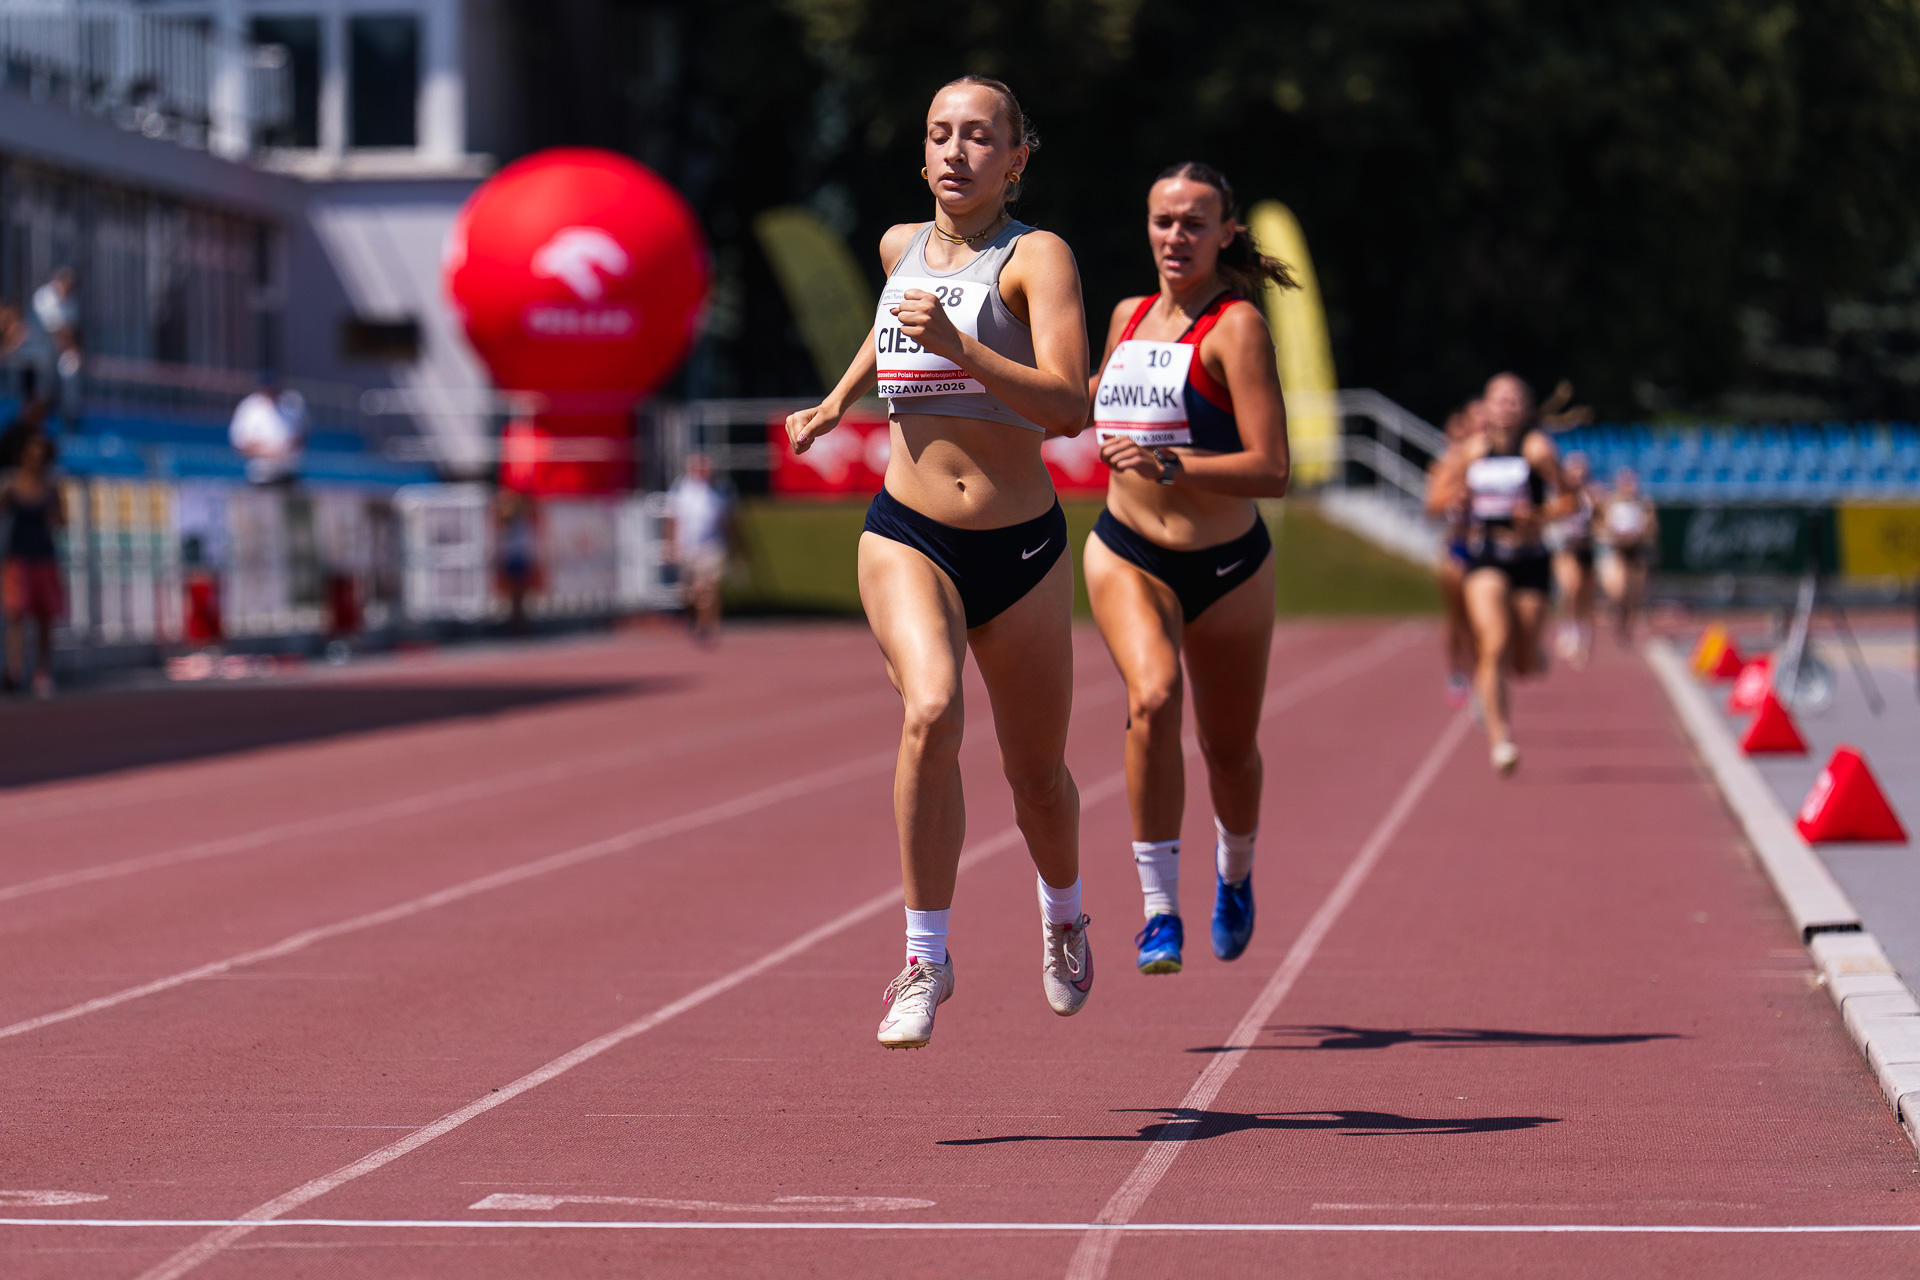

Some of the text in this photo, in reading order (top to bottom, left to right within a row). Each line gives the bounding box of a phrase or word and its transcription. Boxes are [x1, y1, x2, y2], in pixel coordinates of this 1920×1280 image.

[935, 285, 965, 307] 28
[878, 327, 932, 354] CIES
[1147, 349, 1172, 368] 10
[935, 382, 966, 392] 2026
[1098, 385, 1178, 408] GAWLAK
